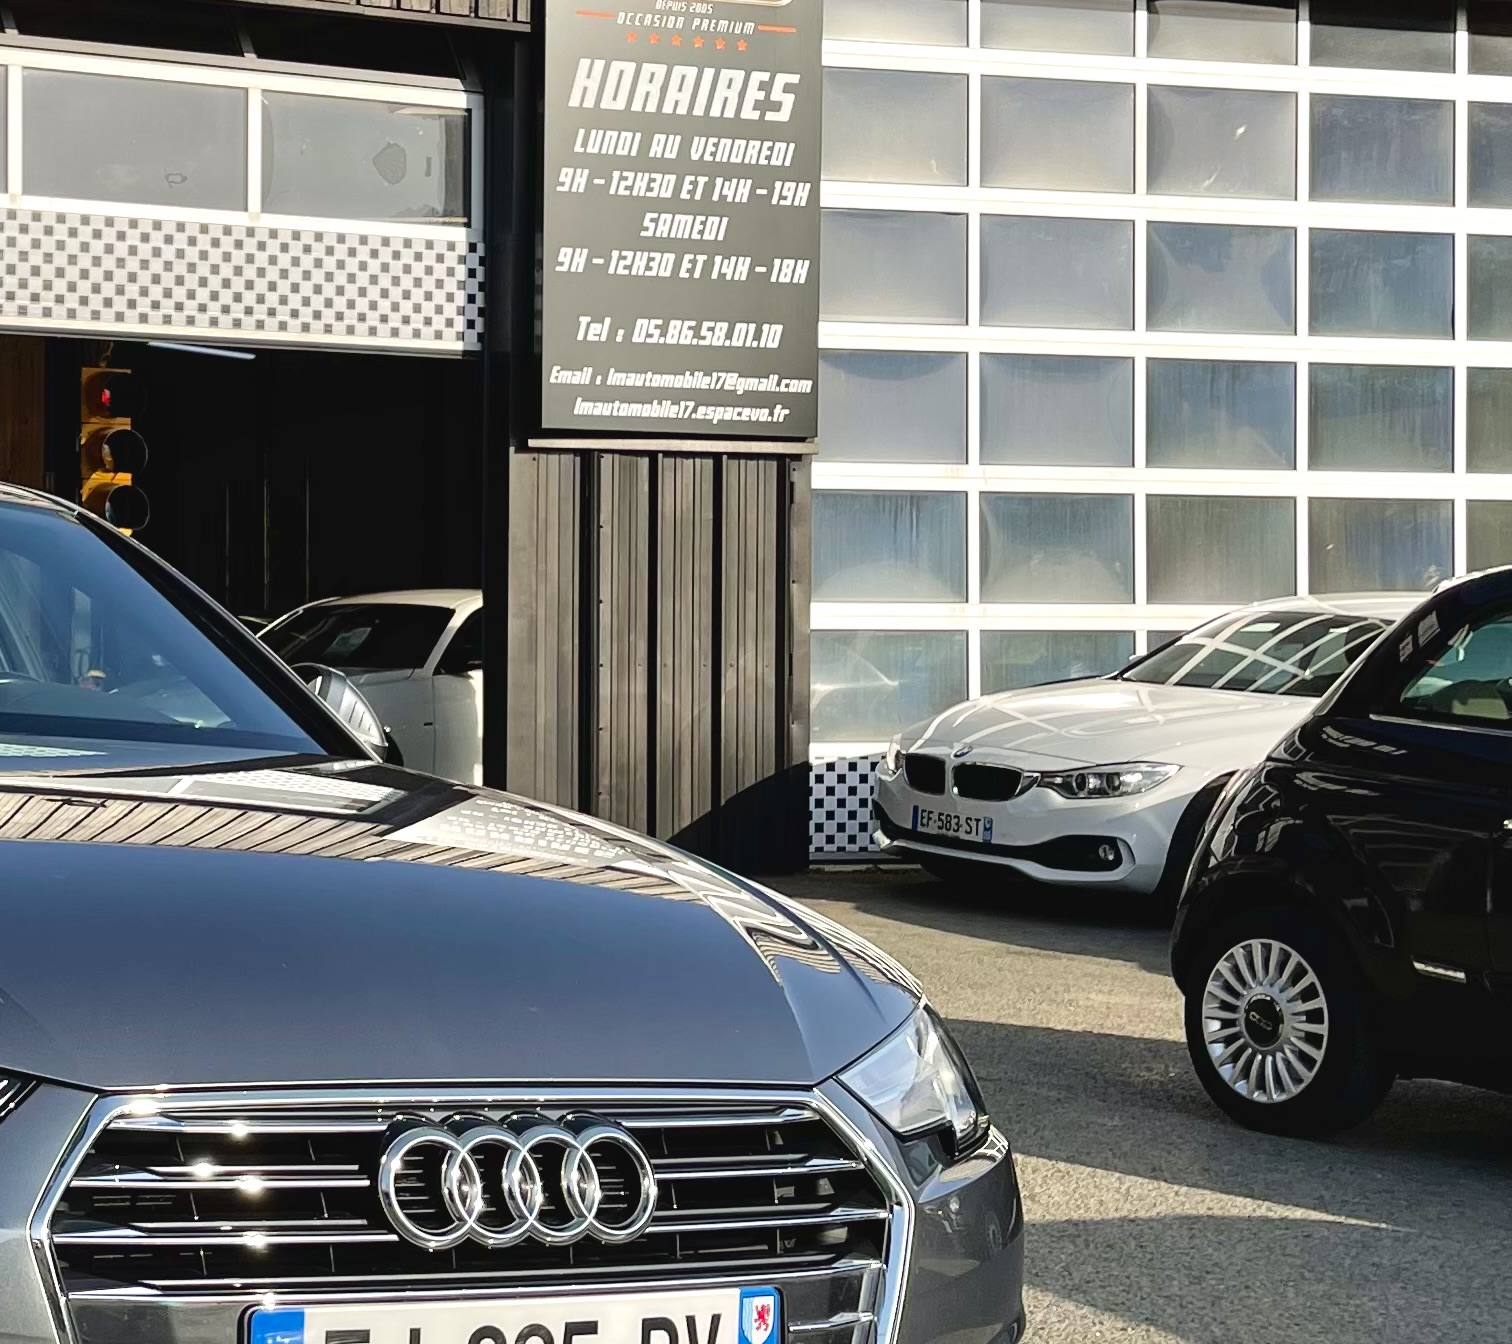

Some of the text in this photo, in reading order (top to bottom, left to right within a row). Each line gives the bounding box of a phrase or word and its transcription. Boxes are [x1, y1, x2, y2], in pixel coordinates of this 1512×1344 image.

[616, 11, 755, 35] OCCASION PREMIUM
[655, 0, 714, 15] DEPUIS 2005
[568, 58, 801, 122] HORAIRES
[574, 128, 796, 167] LUNDI AU VENDREDI
[556, 167, 589, 193] 9H
[609, 170, 677, 199] 12H30
[679, 175, 709, 201] ET
[712, 177, 752, 203] 14H
[771, 181, 812, 207] 19H
[640, 212, 729, 241] SAMEDI
[555, 247, 588, 273] 9H
[608, 250, 676, 278] 12H30
[678, 254, 708, 279] ET
[711, 256, 752, 281] 14H
[770, 258, 811, 284] 18H
[576, 316, 612, 342] Tel
[631, 318, 784, 349] 05.86.58.01.10
[549, 365, 593, 386] Email
[606, 368, 813, 395] lmautomobile17@gmail.com
[574, 397, 791, 425] lmautomobile17.espacevo.fr
